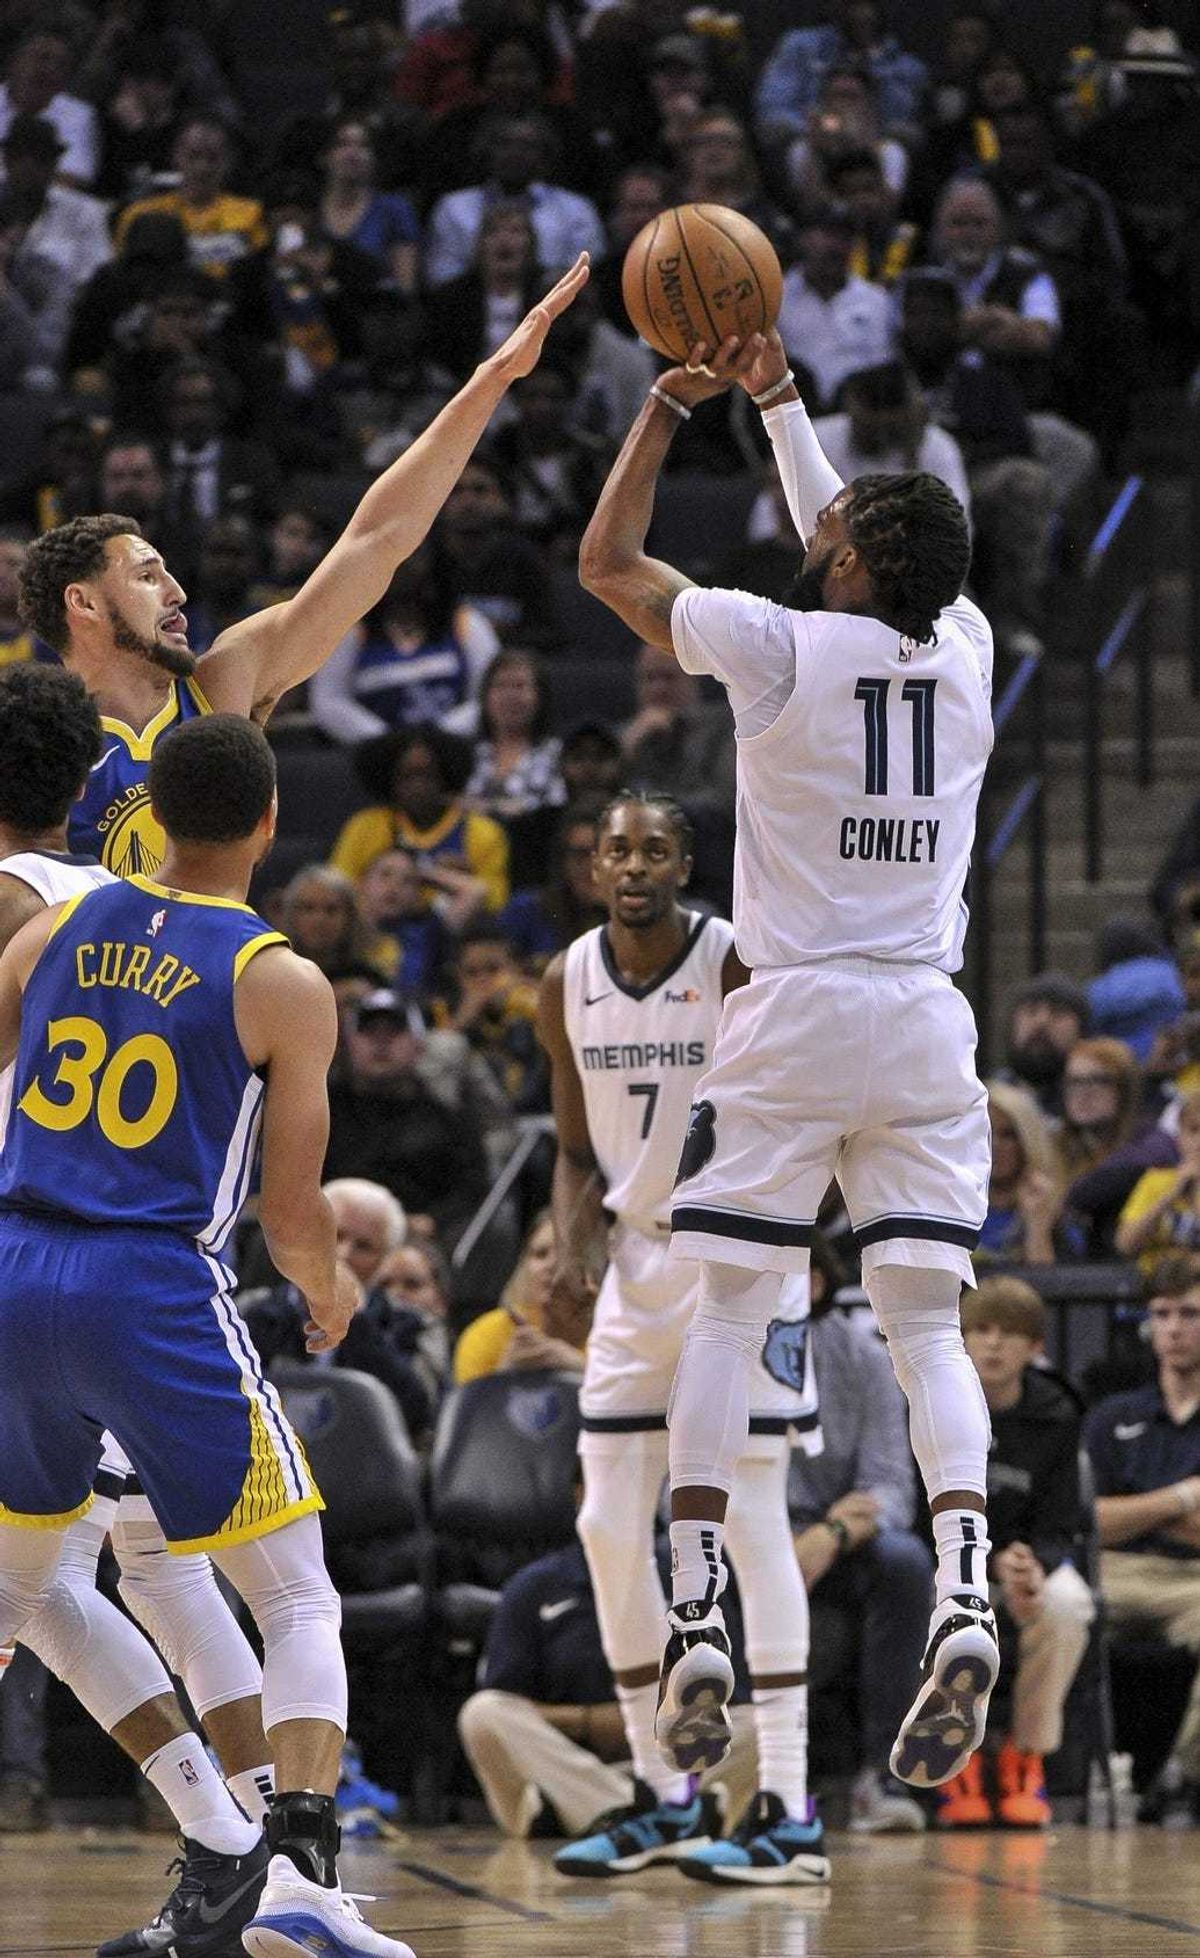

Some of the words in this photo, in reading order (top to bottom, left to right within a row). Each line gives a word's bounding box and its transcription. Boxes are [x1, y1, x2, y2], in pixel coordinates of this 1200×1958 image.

[854, 677, 938, 797] 11
[97, 782, 149, 832] GOLDE
[839, 817, 940, 863] CONLEY
[76, 942, 201, 1008] CURRY
[17, 1016, 178, 1148] 30
[583, 1041, 705, 1070] MEMPHIS
[628, 1082, 659, 1140] 7
[686, 1602, 700, 1618] 45
